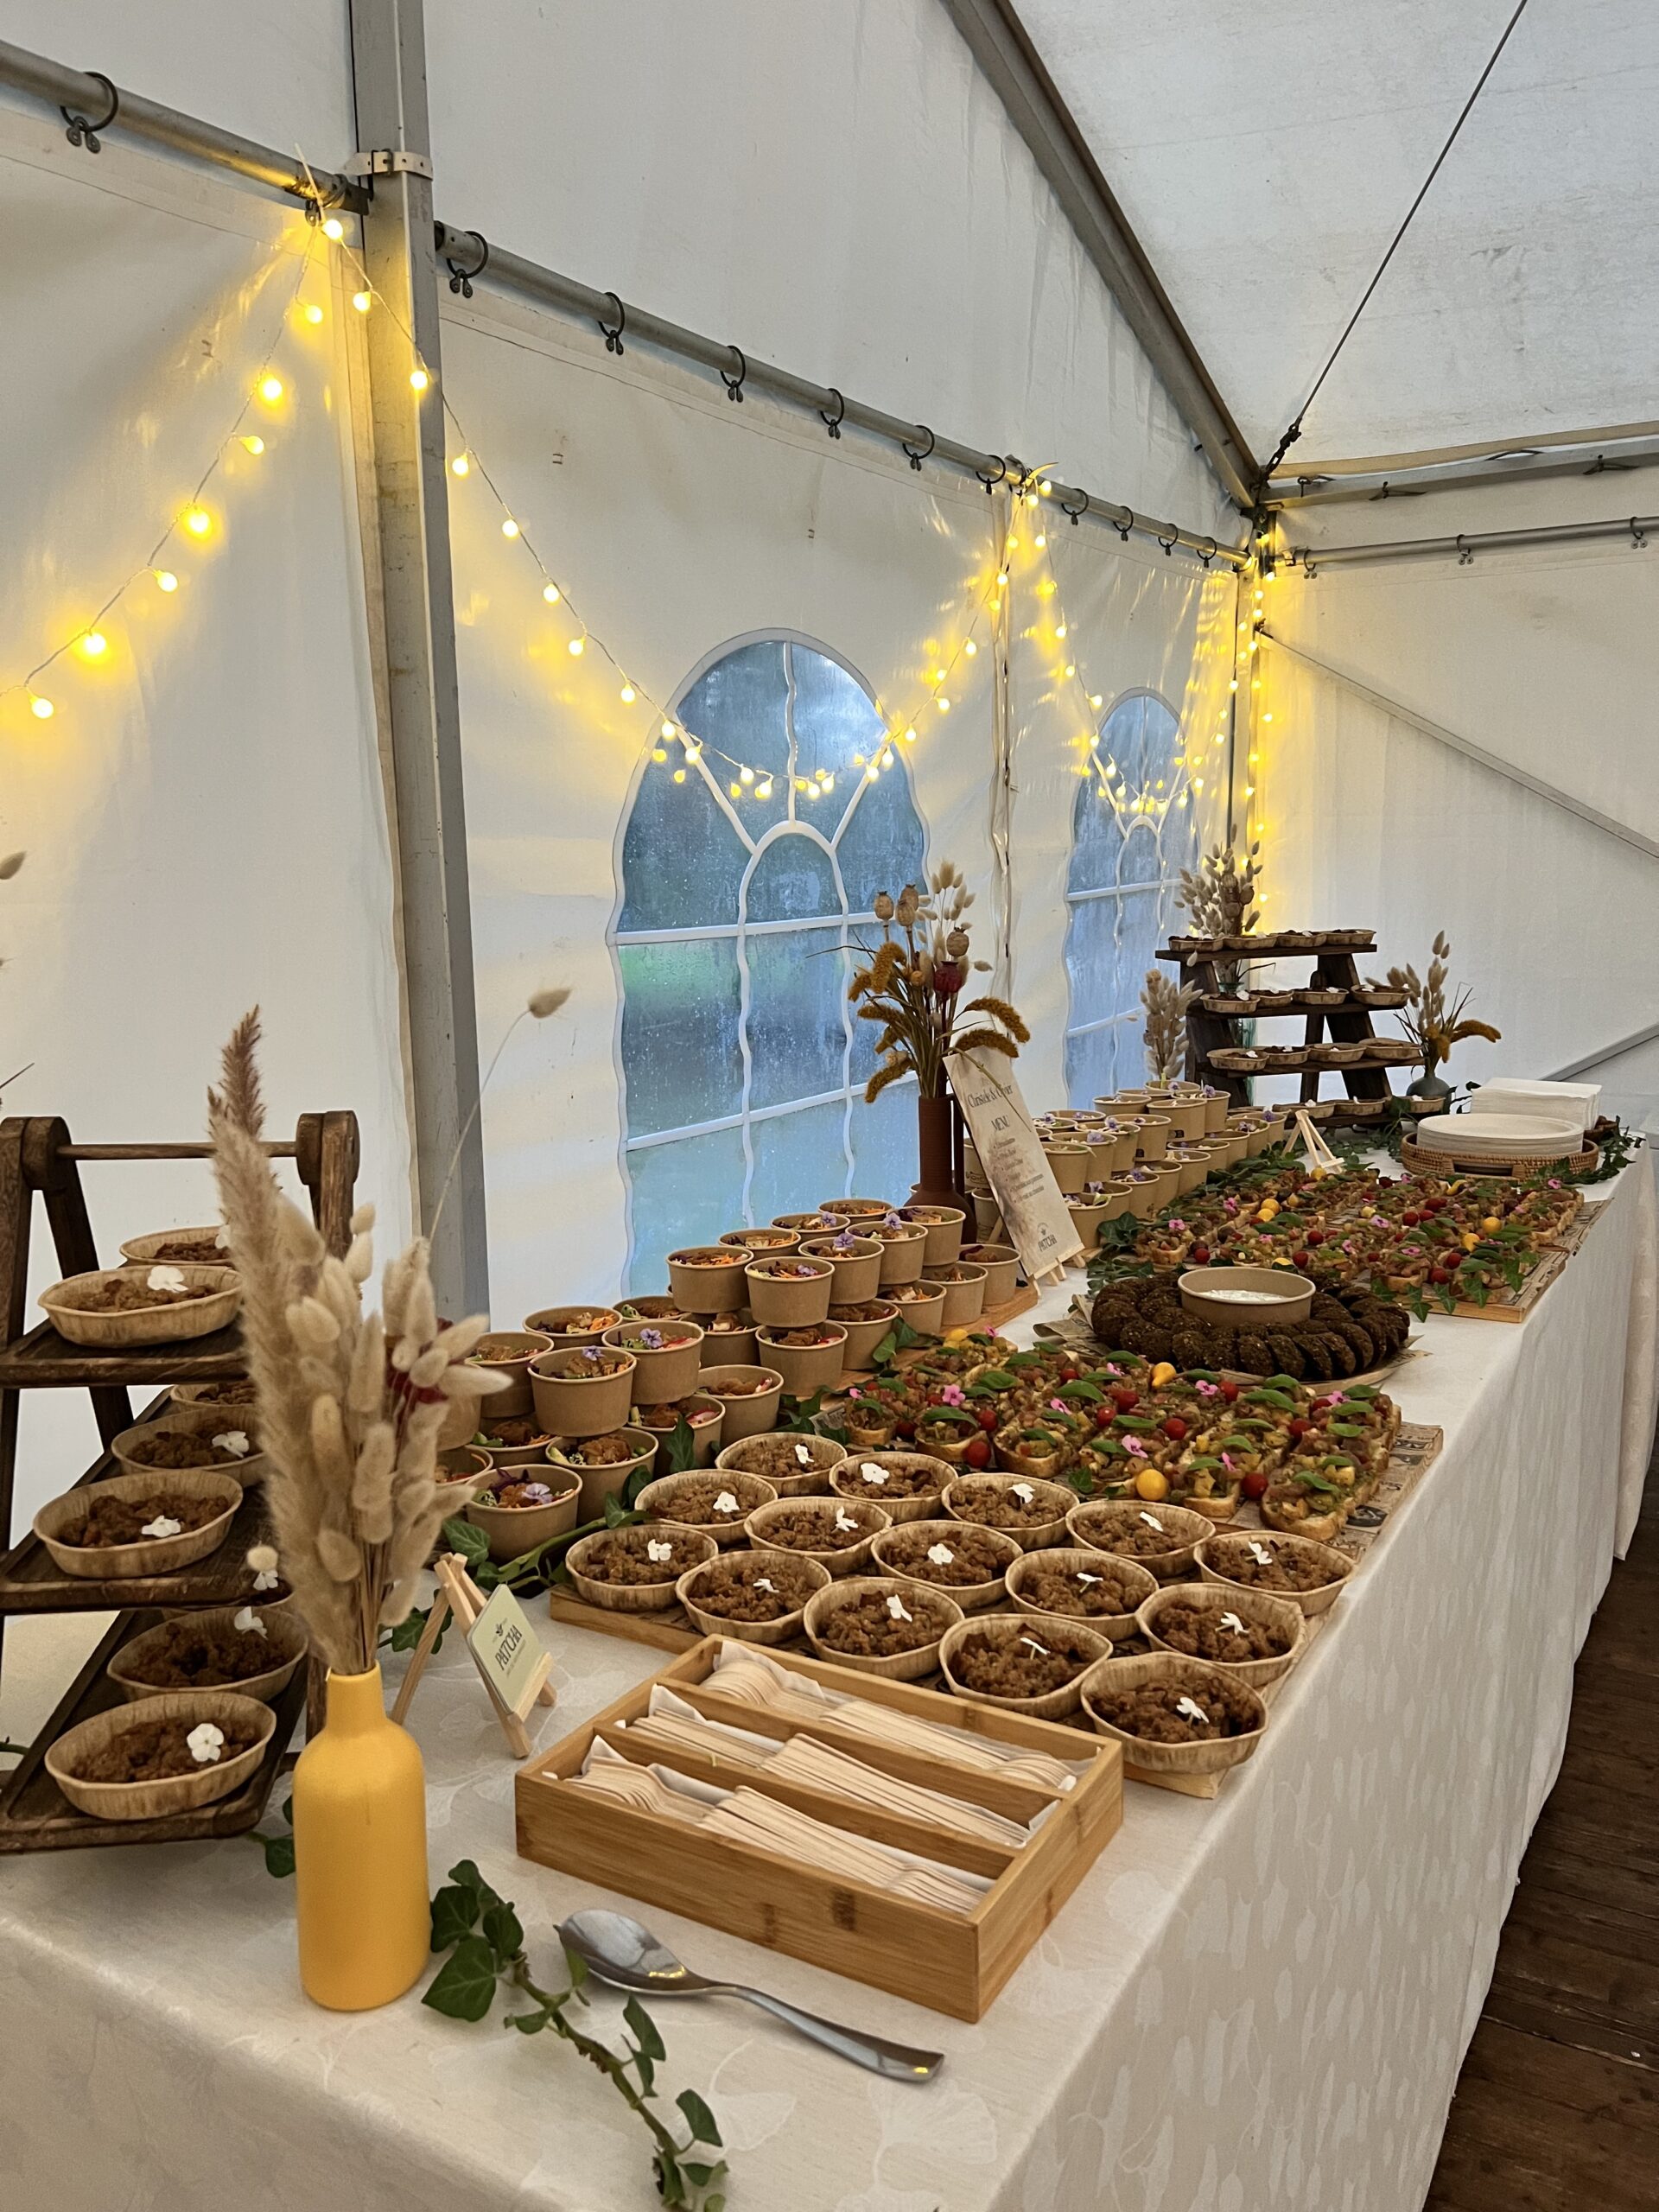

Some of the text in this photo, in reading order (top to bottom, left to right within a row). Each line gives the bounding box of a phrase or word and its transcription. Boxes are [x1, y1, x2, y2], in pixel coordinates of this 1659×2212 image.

[990, 1115, 1010, 1131] MENU
[1038, 1234, 1058, 1252] PATCHA
[495, 1624, 523, 1671] PATCHA
